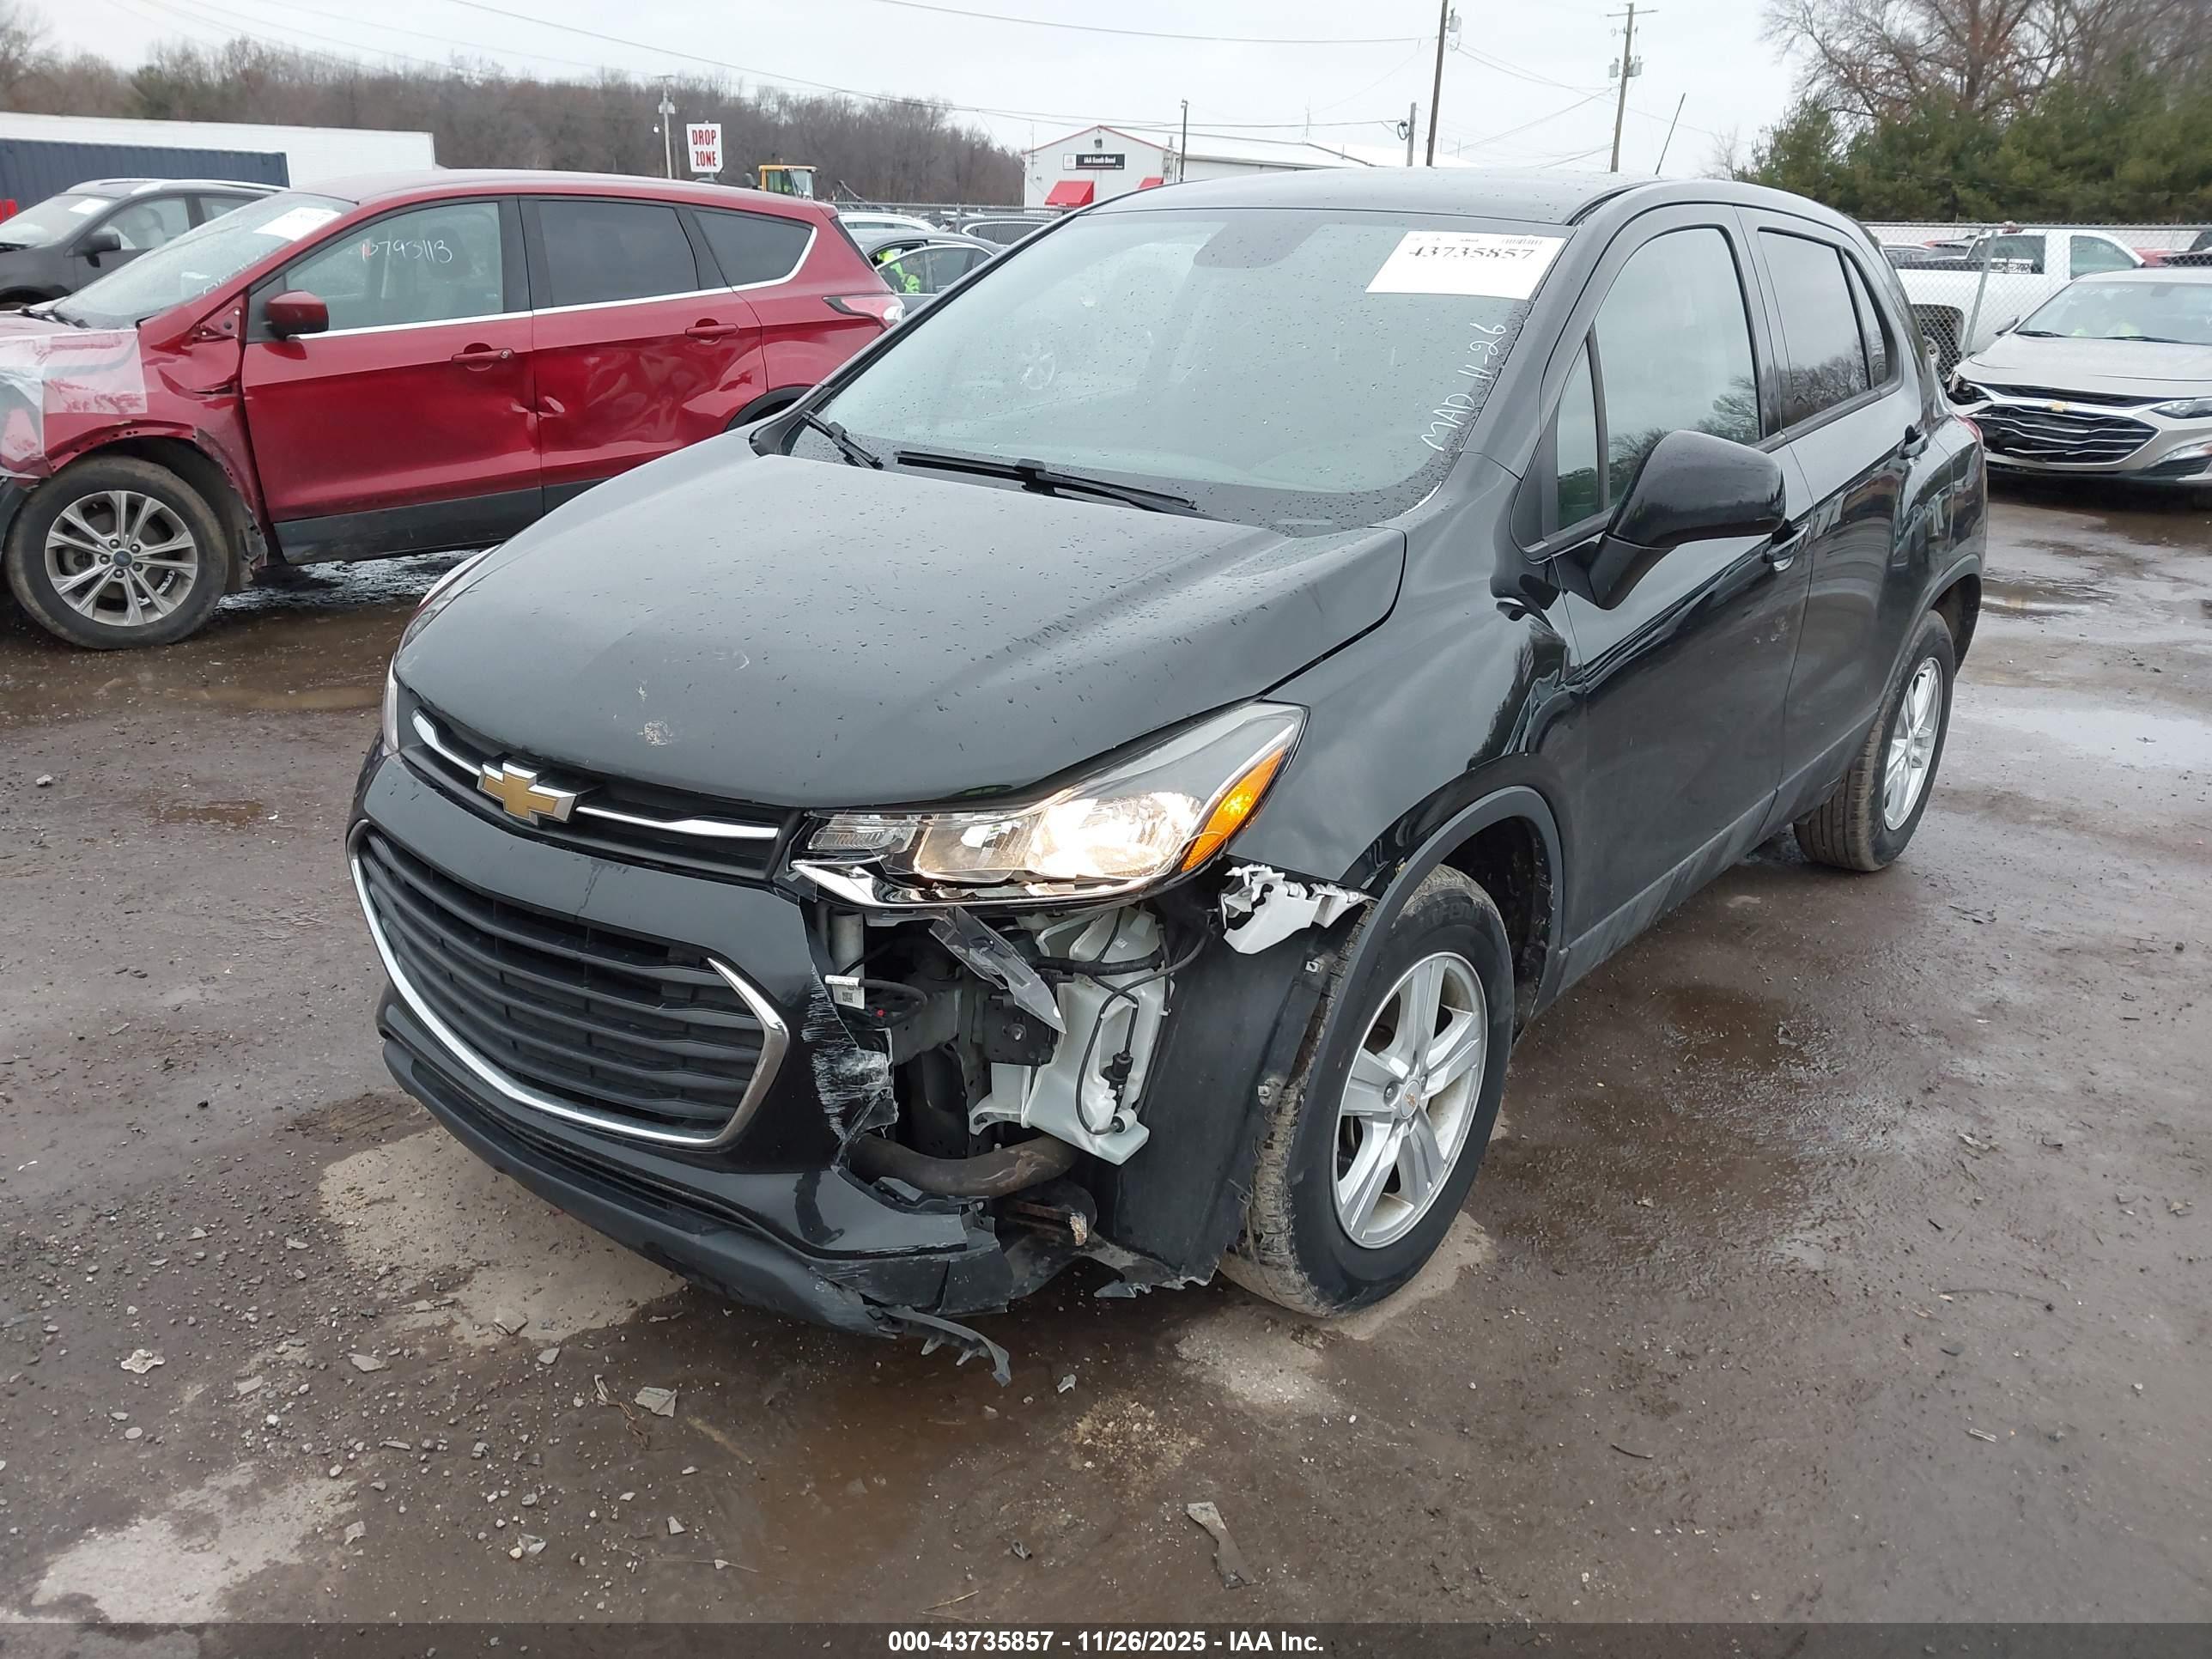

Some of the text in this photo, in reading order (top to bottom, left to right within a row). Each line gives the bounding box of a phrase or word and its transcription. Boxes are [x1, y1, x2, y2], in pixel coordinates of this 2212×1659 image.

[692, 130, 716, 145] DROP
[696, 150, 716, 167] ZONE
[1409, 246, 1535, 259] 43735857
[1420, 392, 1476, 452] MAD
